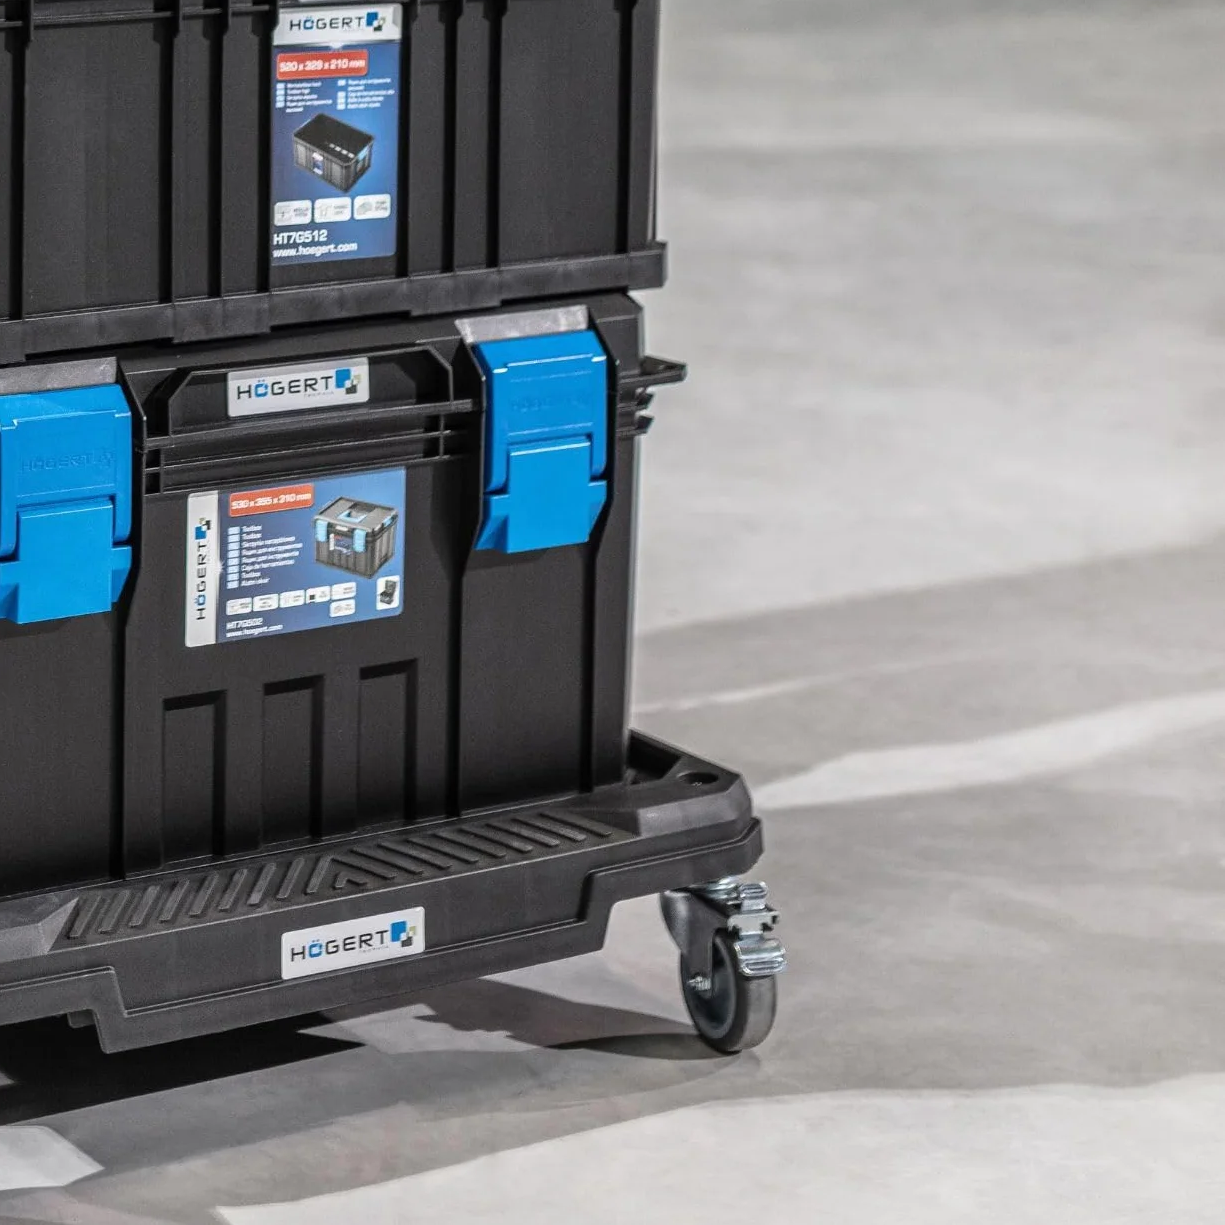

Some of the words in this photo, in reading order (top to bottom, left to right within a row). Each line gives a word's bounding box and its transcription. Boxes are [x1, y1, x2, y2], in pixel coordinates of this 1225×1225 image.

[289, 15, 365, 31] HÖGERT
[273, 229, 328, 245] HT7G512
[272, 242, 358, 257] www.hoegert.com
[237, 375, 333, 400] HÖGERT
[194, 541, 207, 621] HÖGERT
[291, 929, 389, 962] HÖGERT
